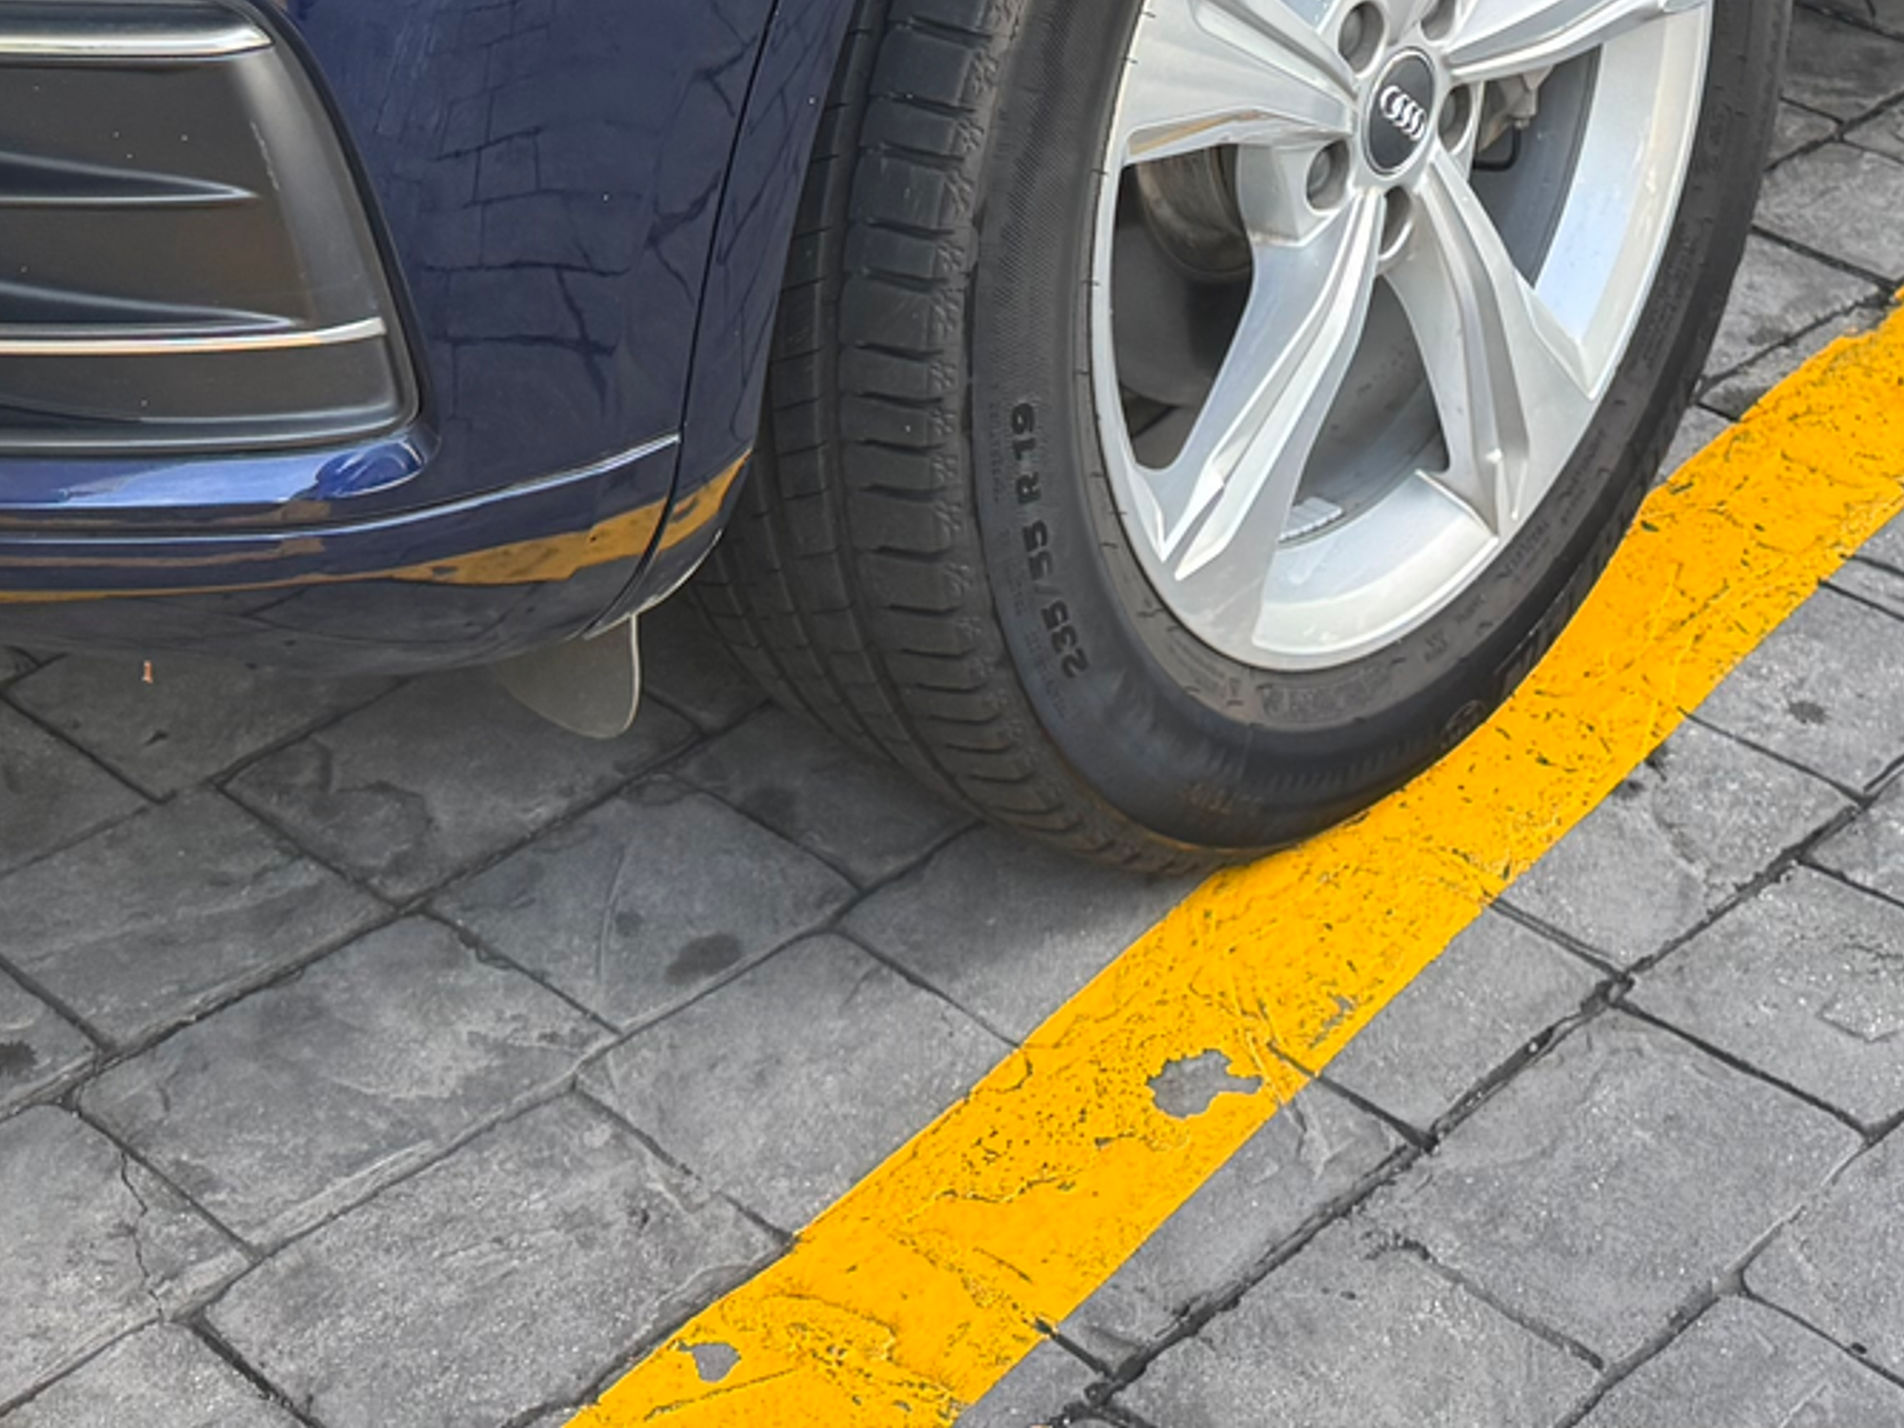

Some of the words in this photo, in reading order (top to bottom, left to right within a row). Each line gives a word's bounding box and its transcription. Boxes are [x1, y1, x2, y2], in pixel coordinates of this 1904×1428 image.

[1010, 401, 1037, 462] 19
[1015, 471, 1042, 505] R
[1022, 519, 1090, 680] 235/55
